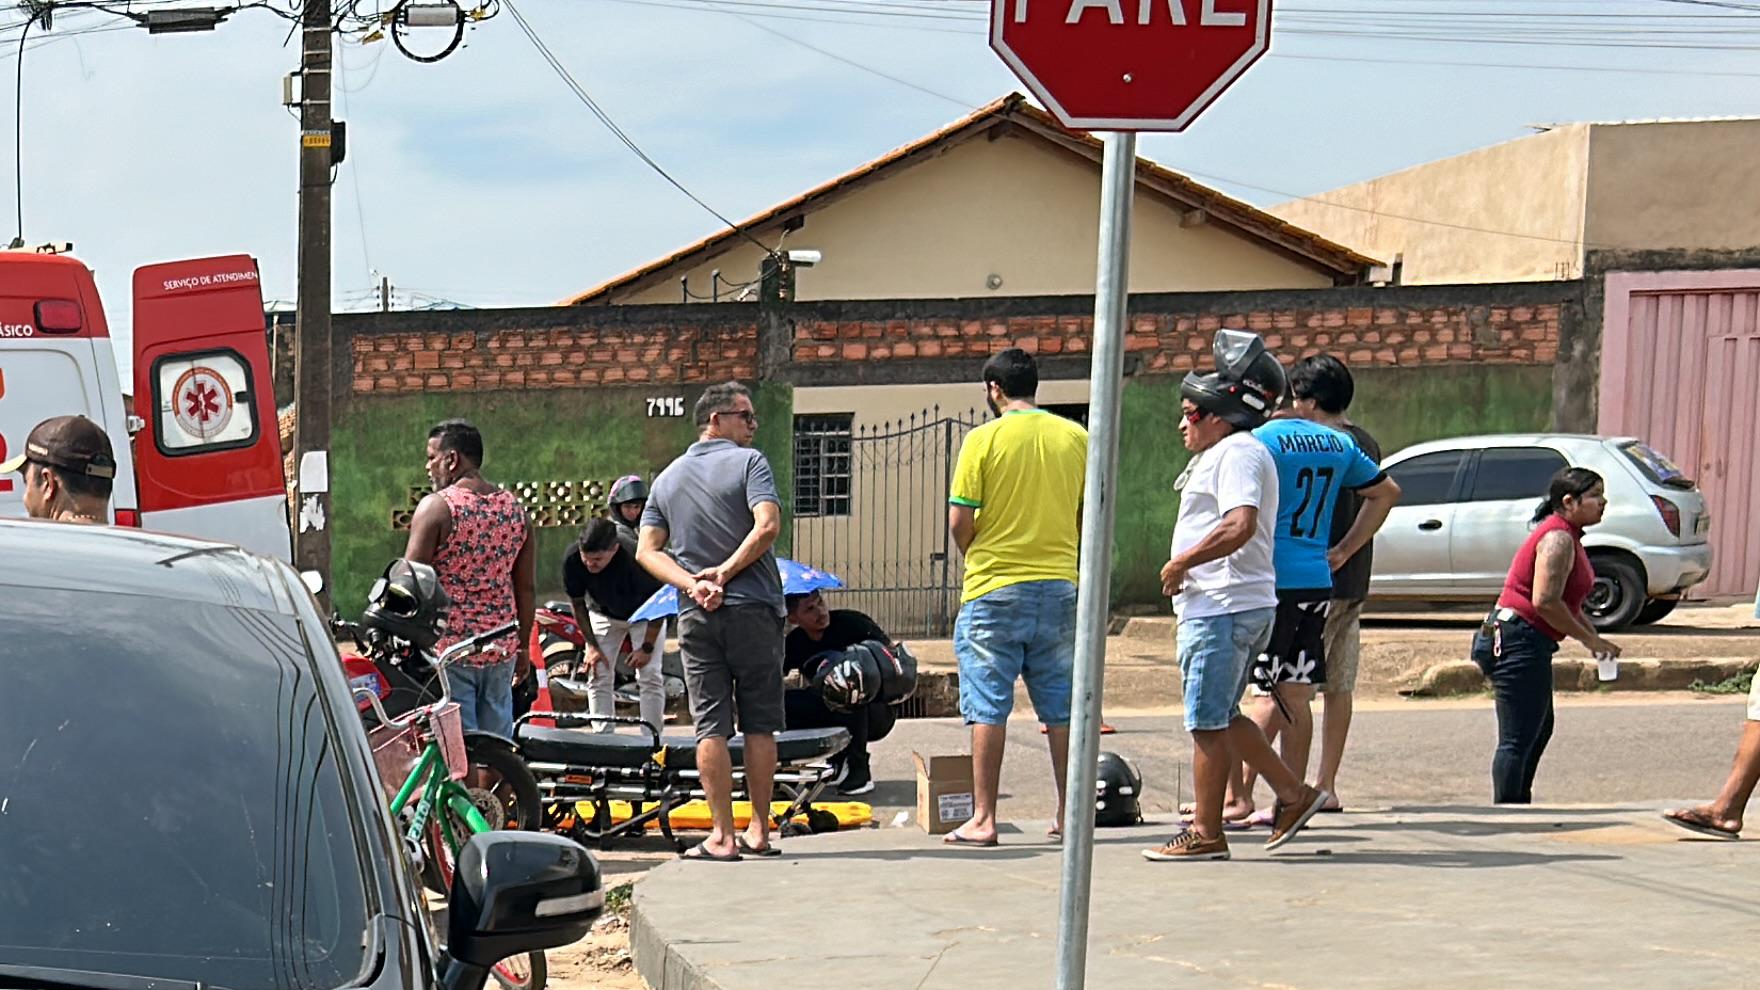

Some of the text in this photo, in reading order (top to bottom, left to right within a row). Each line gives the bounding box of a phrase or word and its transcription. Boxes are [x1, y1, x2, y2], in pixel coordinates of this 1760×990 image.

[163, 277, 199, 290] SERVIÇO
[199, 275, 211, 285] DE
[646, 397, 685, 417] 7996
[1277, 431, 1344, 453] MÁRCIO
[1290, 467, 1334, 538] 27
